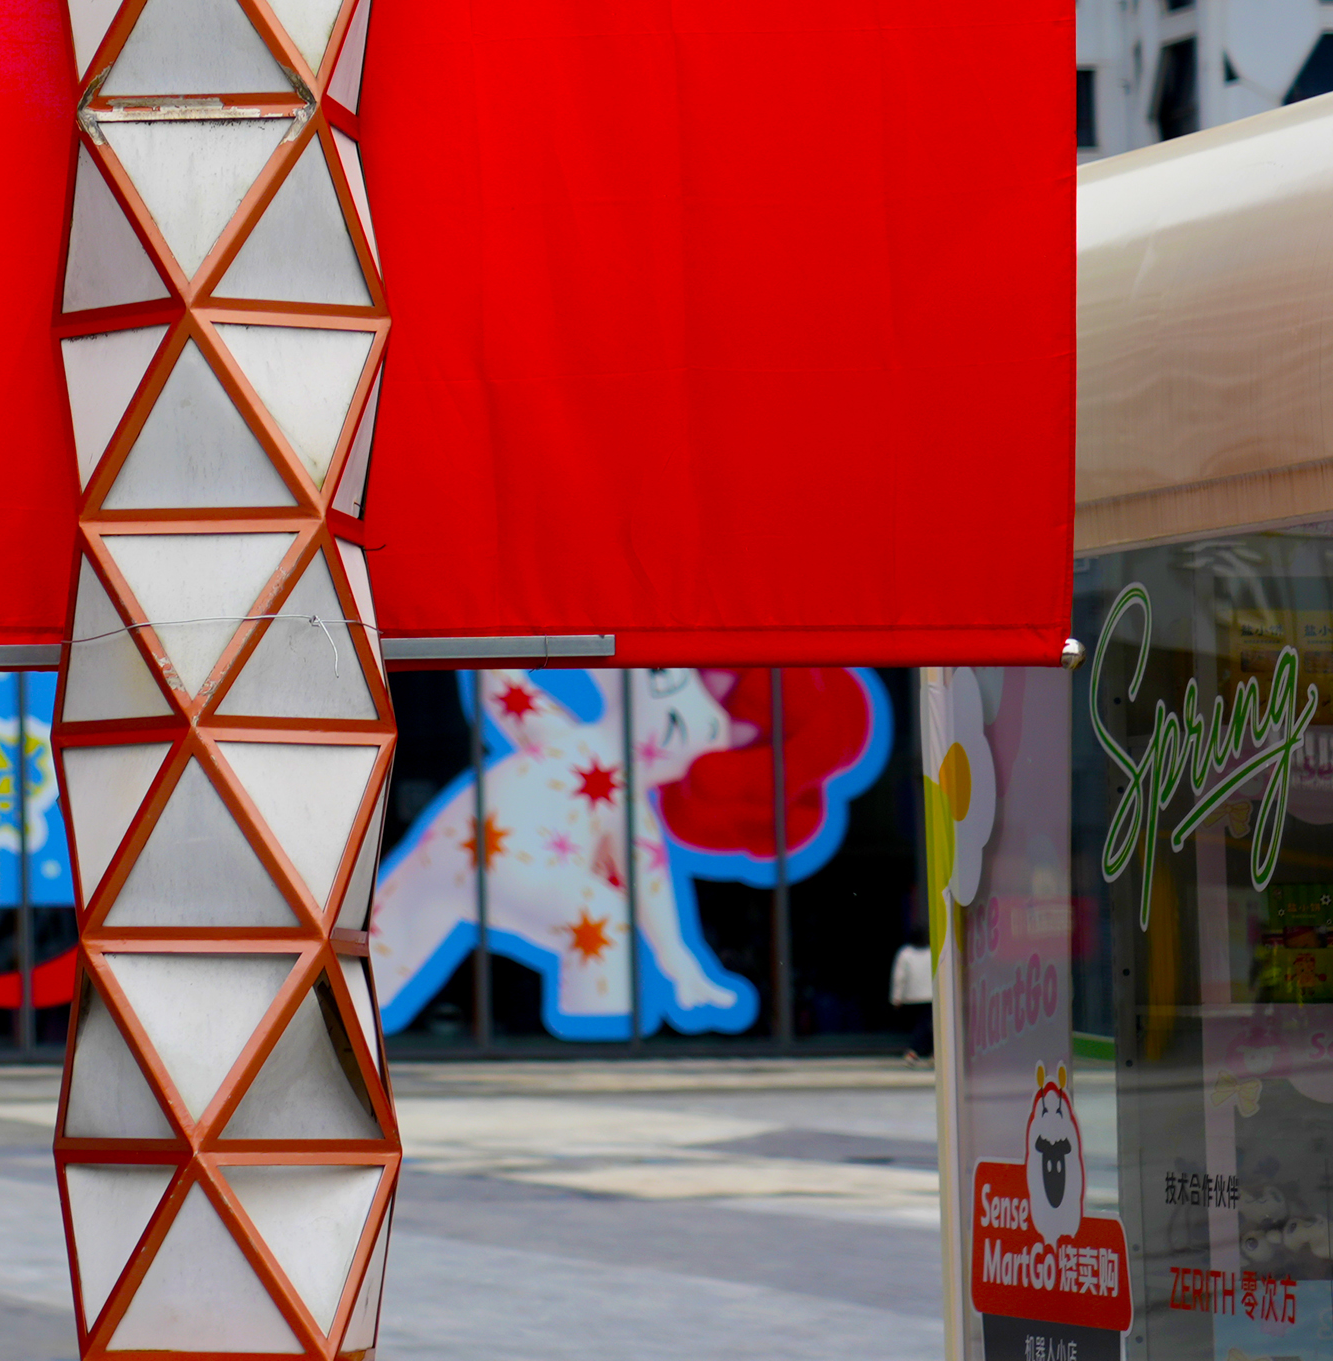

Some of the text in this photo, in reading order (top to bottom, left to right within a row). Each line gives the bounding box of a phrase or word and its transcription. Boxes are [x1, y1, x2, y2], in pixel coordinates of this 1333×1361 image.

[1090, 582, 1318, 932] Spring
[981, 1183, 1029, 1231] Sense
[1165, 1171, 1240, 1209] 技术合作伙伴
[983, 1238, 1120, 1298] MartGo 烧卖购
[1169, 1266, 1297, 1325] ZERITH 零次方
